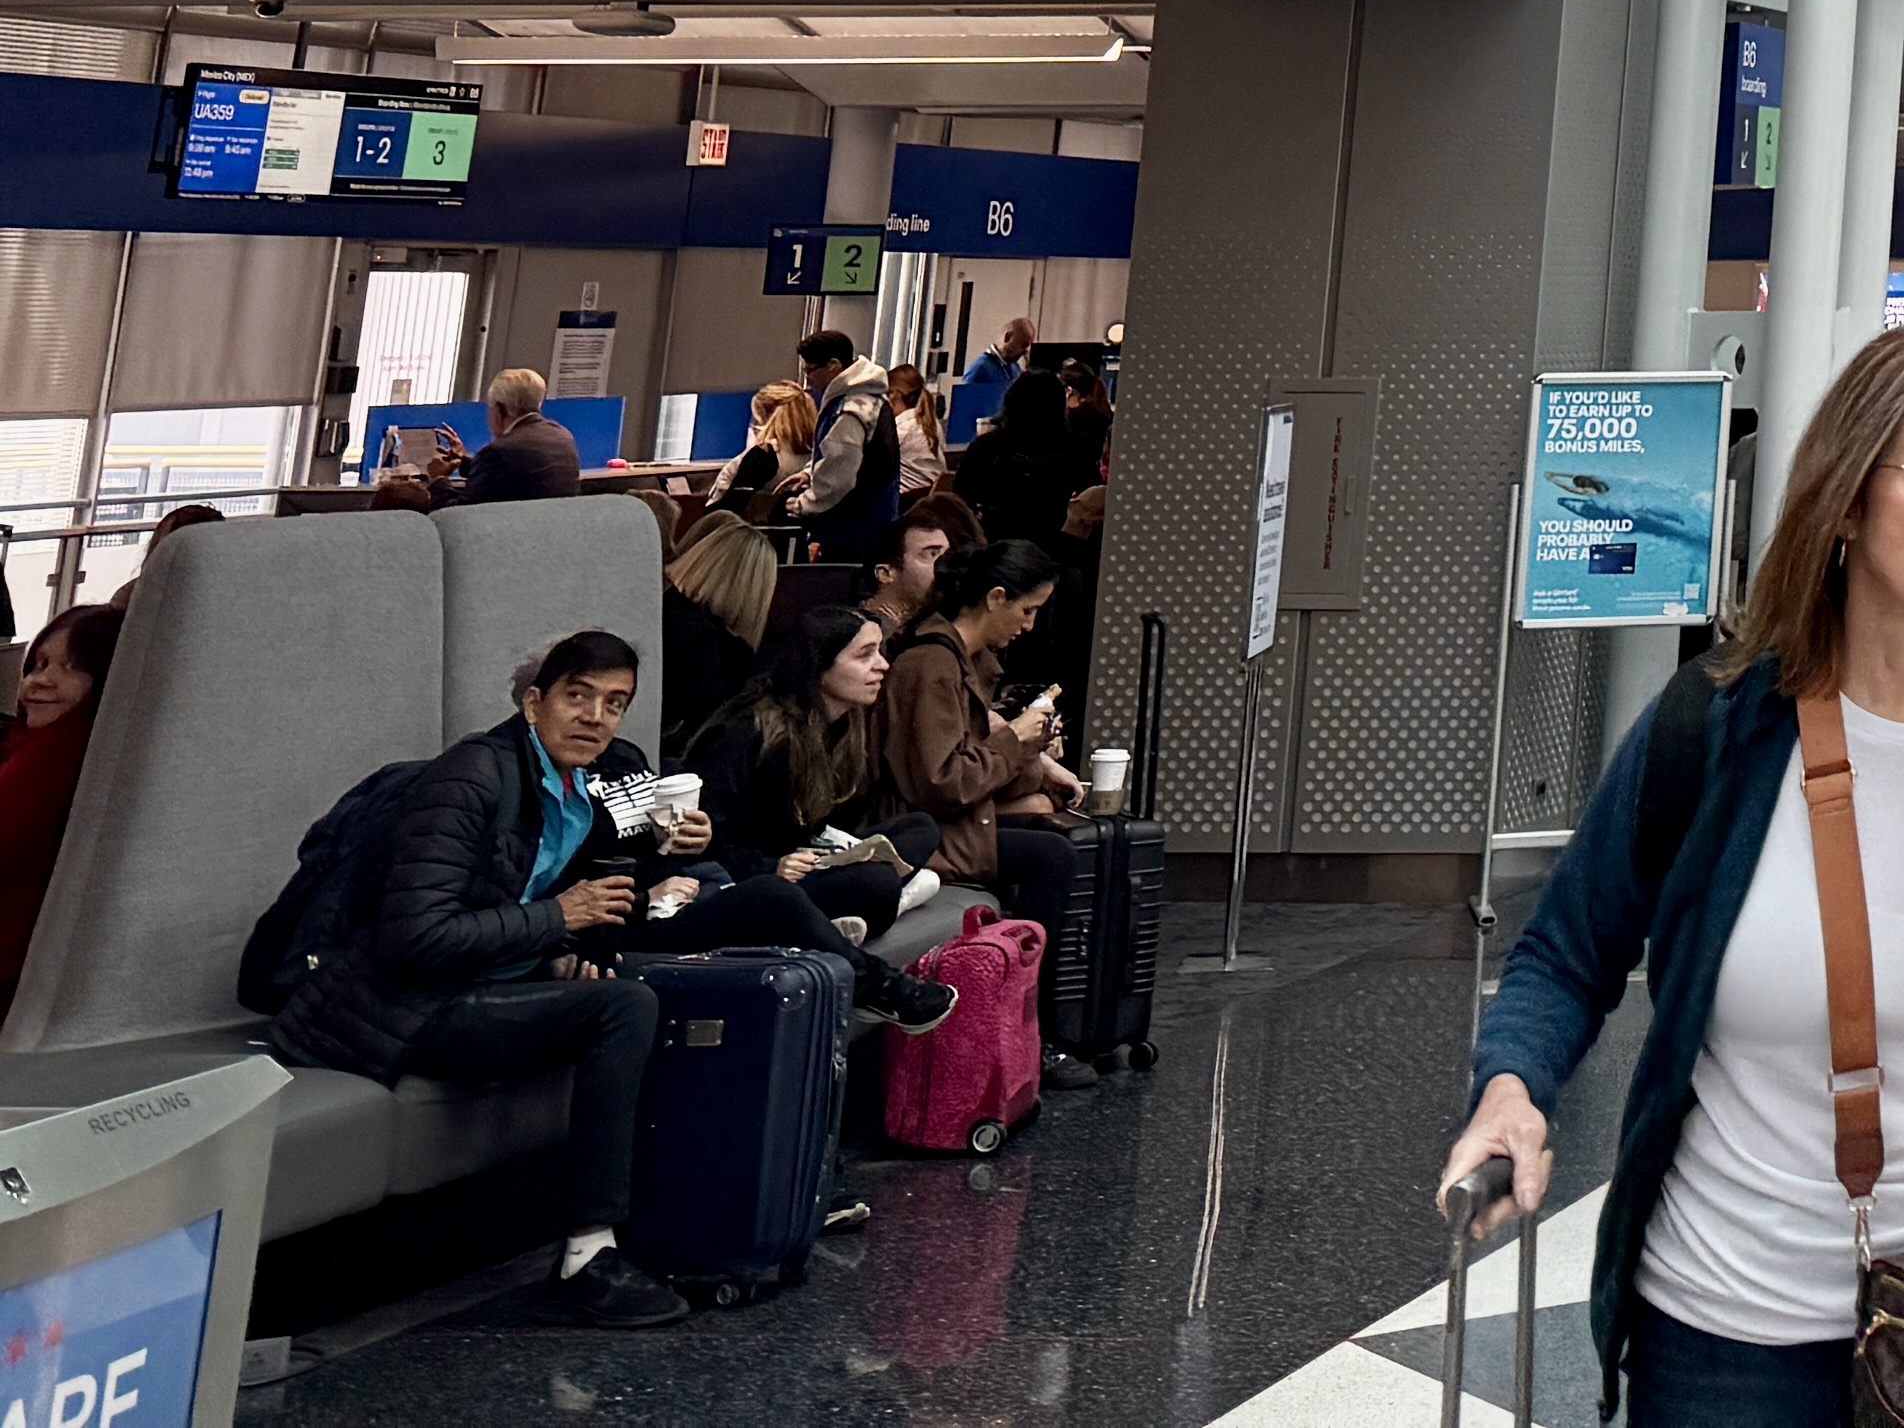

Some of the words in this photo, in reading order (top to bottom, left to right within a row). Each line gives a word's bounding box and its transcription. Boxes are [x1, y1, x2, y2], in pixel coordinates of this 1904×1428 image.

[1742, 40, 1757, 68] B6
[1741, 74, 1767, 98] boarding
[194, 103, 235, 121] UA359
[1765, 122, 1773, 145] 2
[355, 136, 391, 164] 1-2
[433, 140, 446, 165] 3
[910, 215, 931, 234] line
[987, 200, 1014, 236] B6
[792, 244, 804, 268] 1
[844, 243, 862, 268] 2
[1549, 391, 1561, 404] IF
[1564, 391, 1609, 404] YOU'D
[1611, 391, 1641, 404] LIKE
[1548, 405, 1567, 417] TO
[1569, 405, 1610, 417] EARN
[1612, 405, 1632, 417] UP
[1634, 404, 1653, 417] TO
[1546, 417, 1638, 440] 75,000
[1545, 440, 1597, 453] BONUS
[1599, 440, 1645, 454] MILES,
[1539, 520, 1572, 533] YOU
[1572, 519, 1633, 533] SHOULD
[1537, 533, 1614, 546] PROBABLY
[1536, 547, 1577, 561] HAVE
[1579, 547, 1590, 561] A
[88, 1090, 191, 1136] RECYCLING
